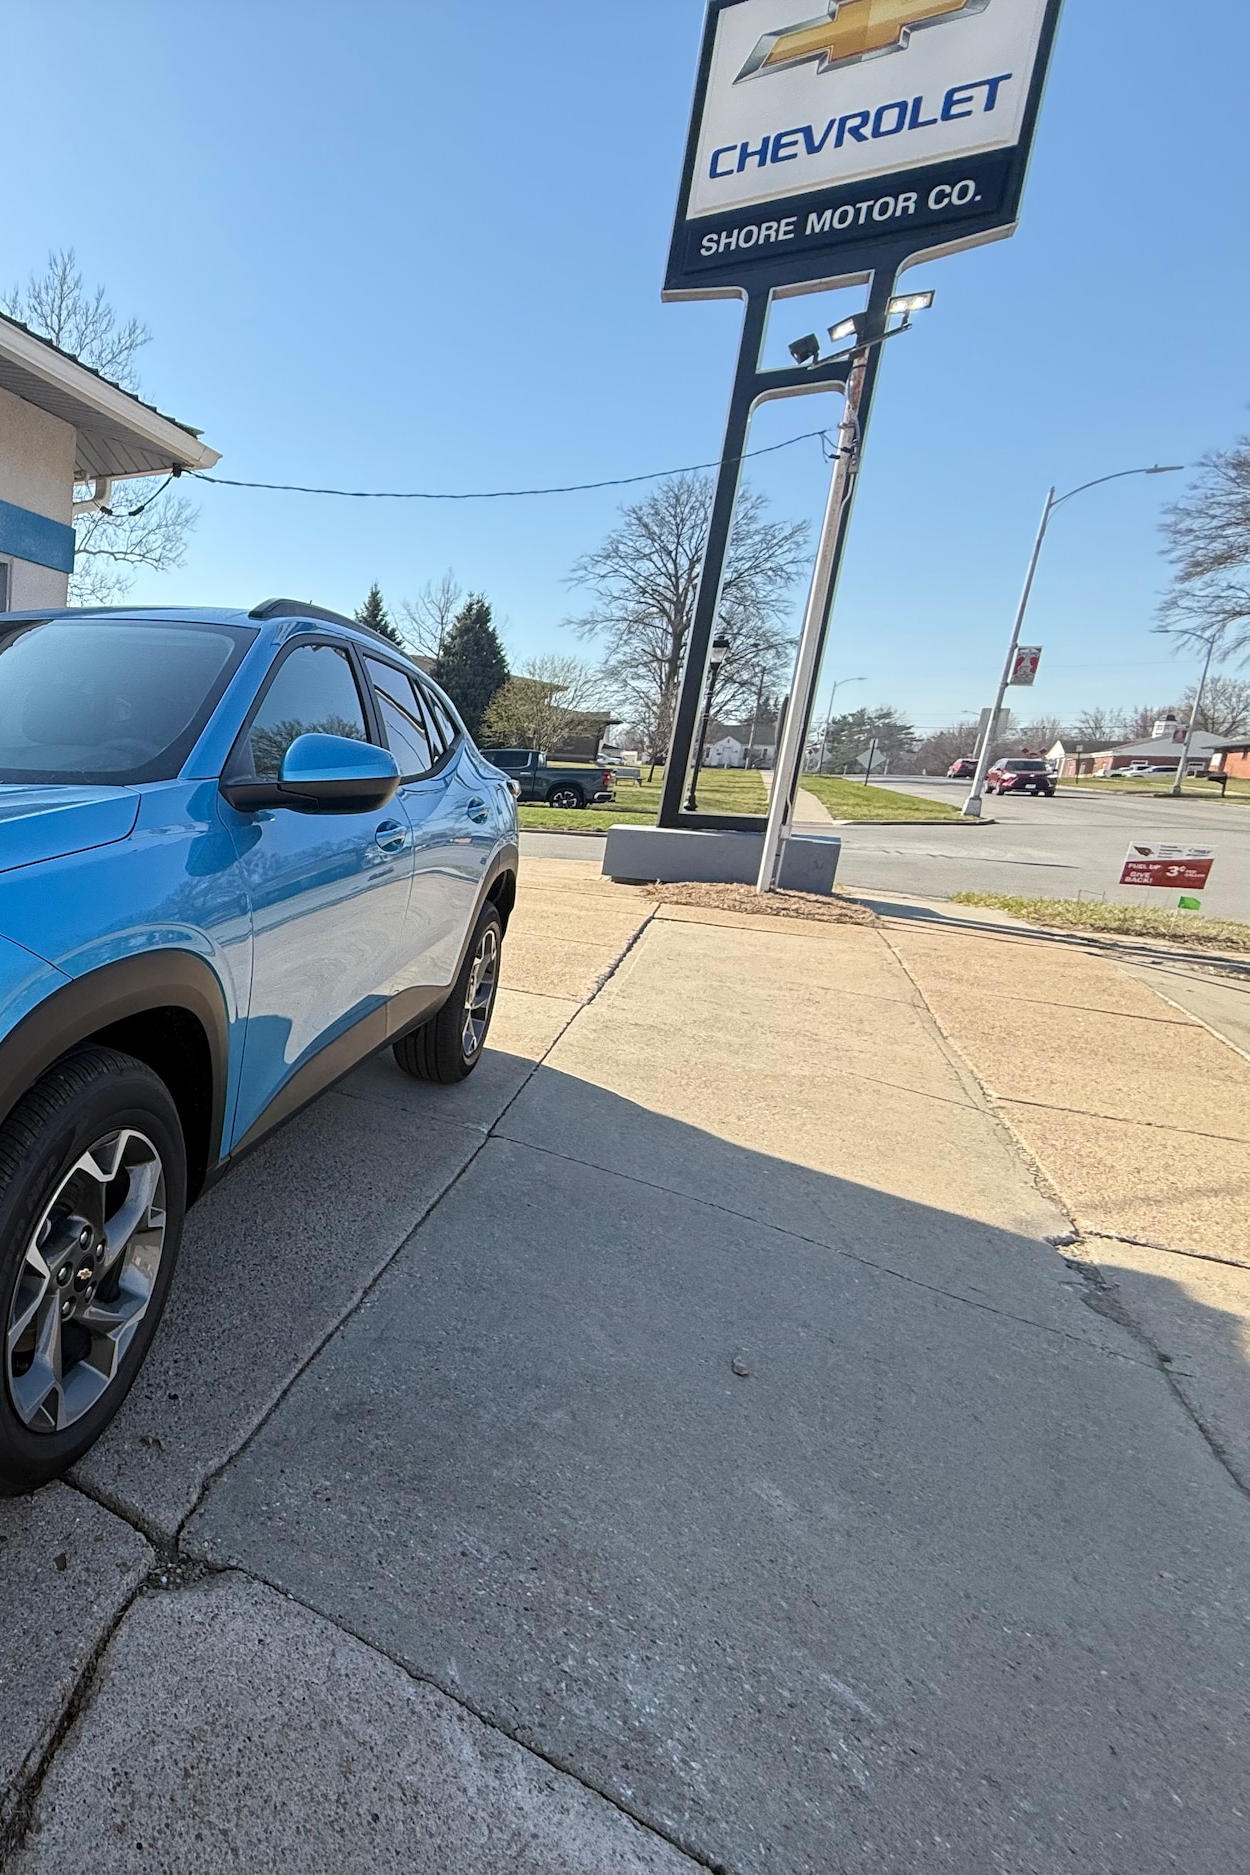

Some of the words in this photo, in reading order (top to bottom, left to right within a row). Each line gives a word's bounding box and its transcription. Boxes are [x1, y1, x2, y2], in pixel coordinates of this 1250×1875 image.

[709, 73, 1012, 179] CHEVROLET
[700, 216, 797, 257] SHORE
[805, 192, 918, 236] MOTOR
[928, 179, 982, 211] CO.
